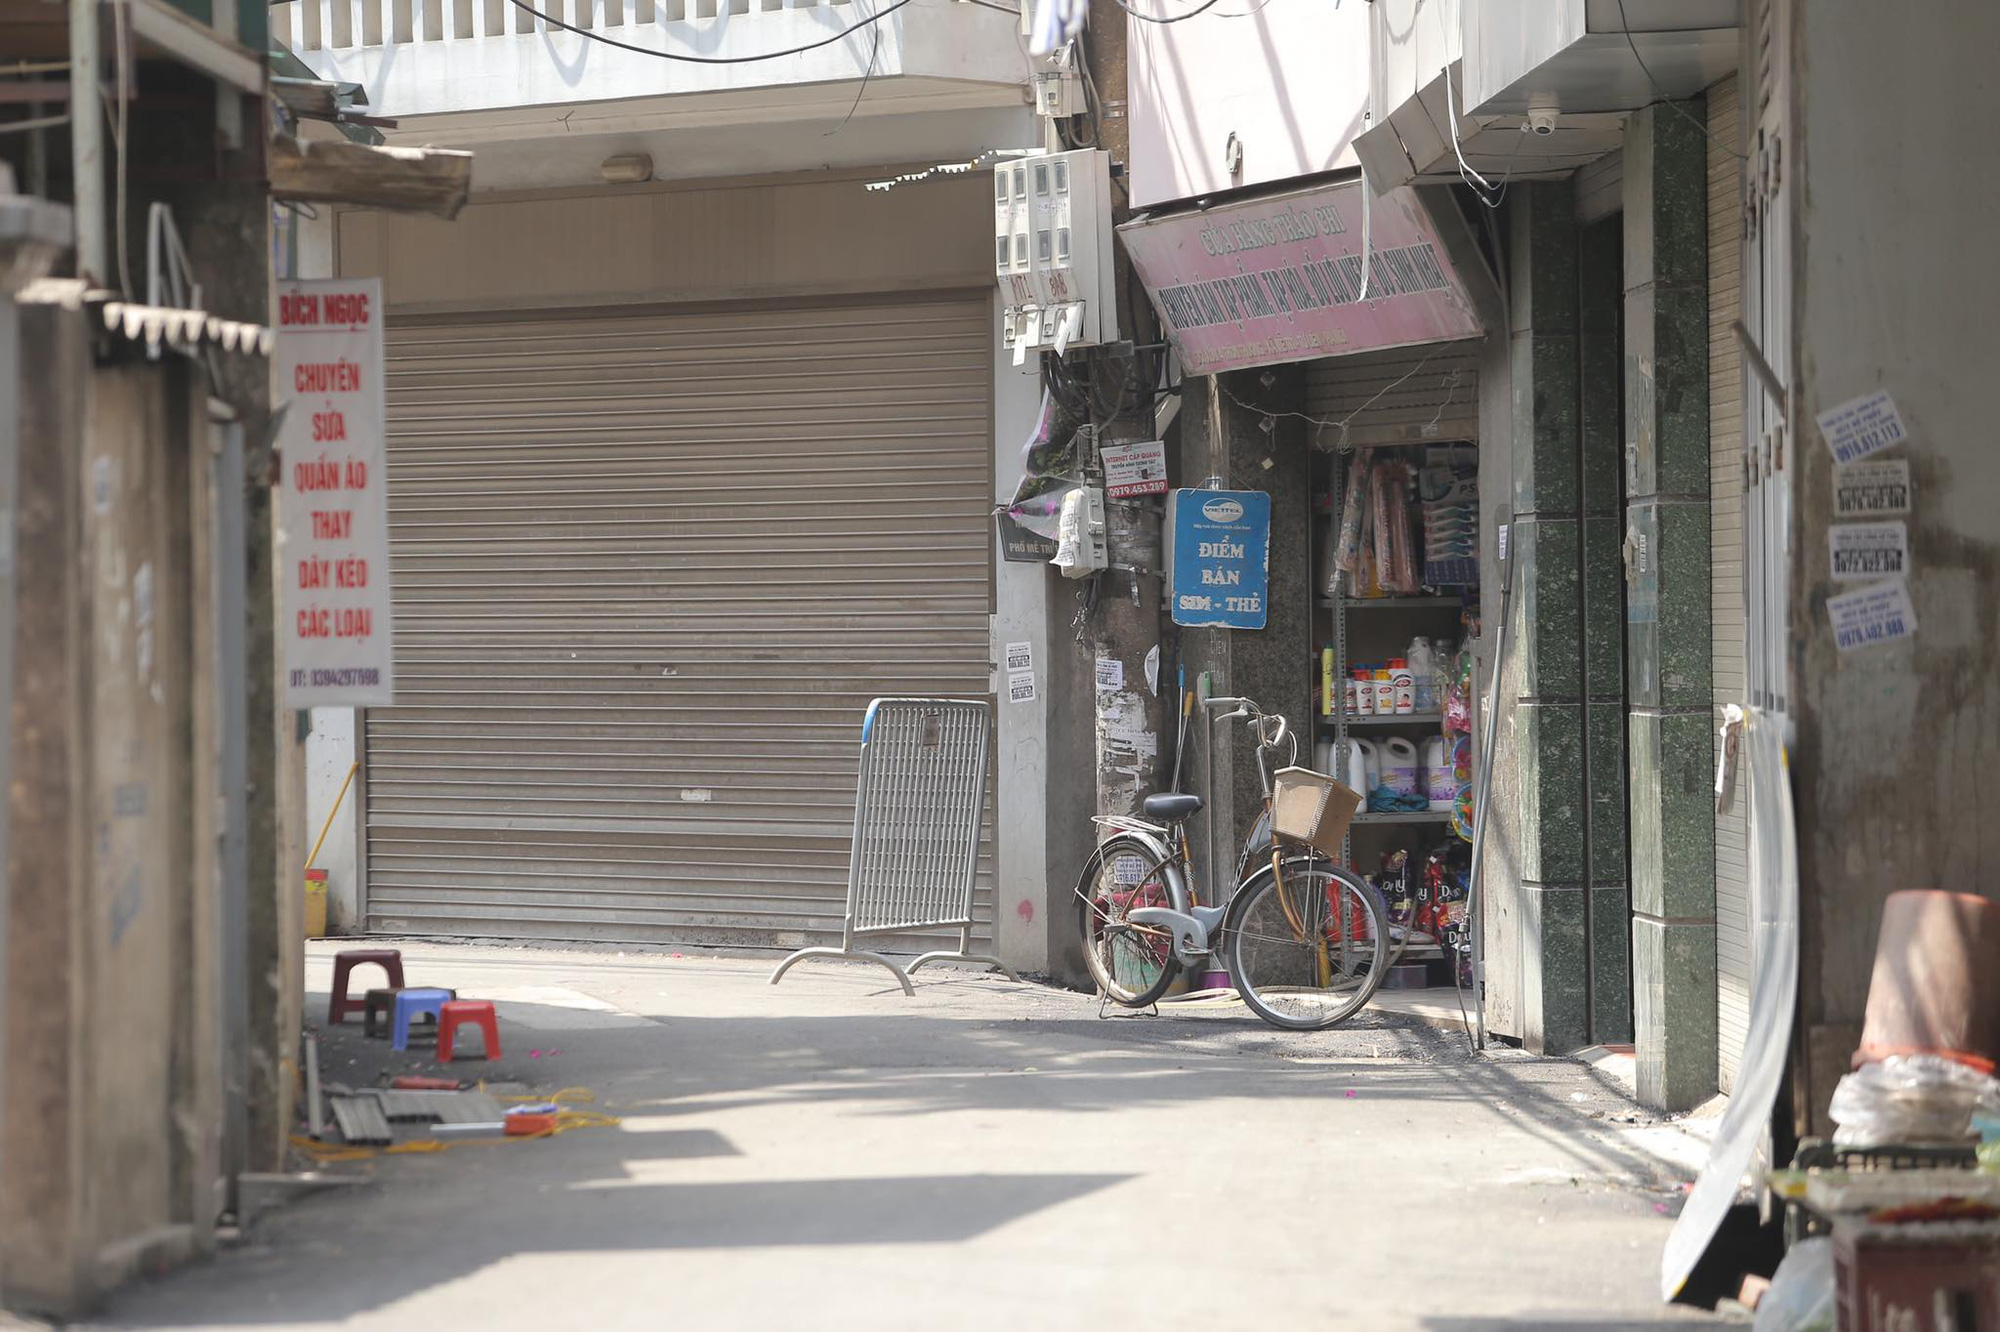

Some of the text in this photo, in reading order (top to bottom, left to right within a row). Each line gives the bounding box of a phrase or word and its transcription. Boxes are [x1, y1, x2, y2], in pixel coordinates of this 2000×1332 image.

[323, 292, 368, 332] NGỌC
[295, 358, 360, 393] CHUYÊN
[313, 400, 346, 442] SỬA
[344, 454, 367, 490] ÁO
[311, 510, 352, 540] THAY
[1198, 535, 1244, 559] ĐIỂM
[298, 554, 368, 589] DÂY KÉO
[1201, 566, 1240, 586] BÁN
[1225, 592, 1261, 613] THẺ
[297, 603, 372, 643] CÁC LOẠI
